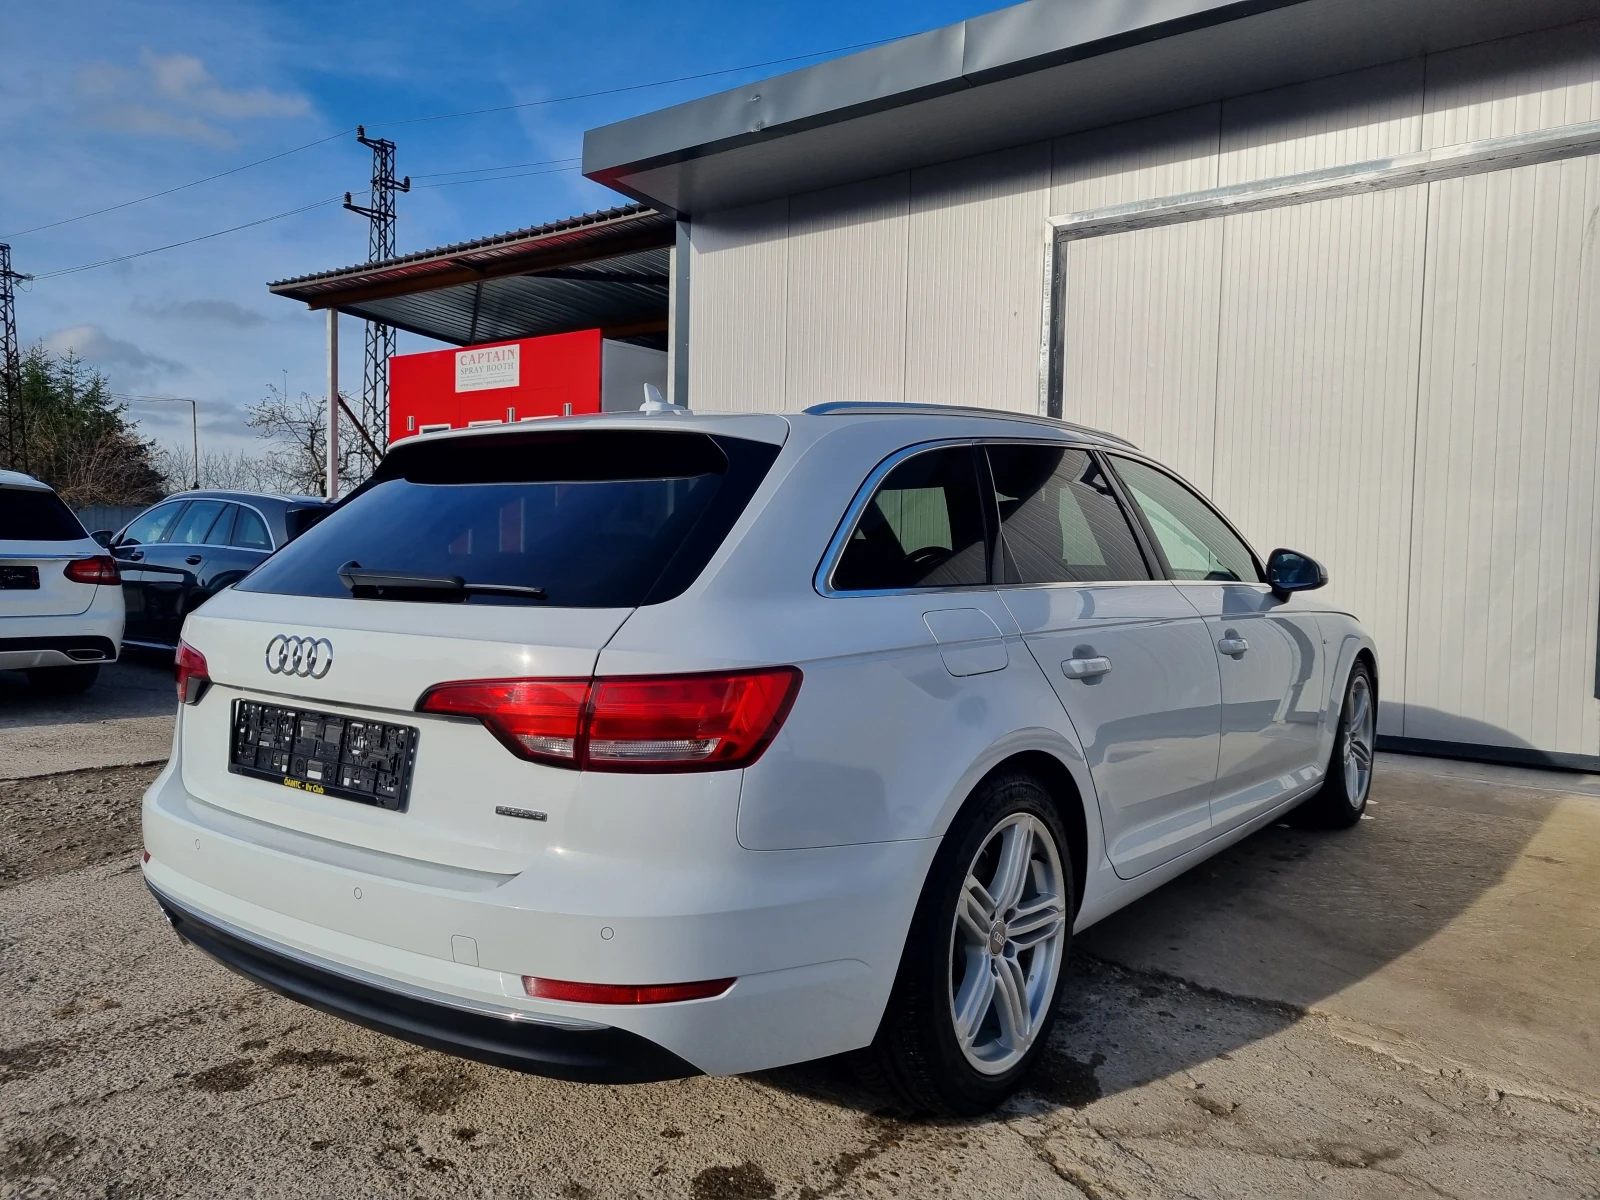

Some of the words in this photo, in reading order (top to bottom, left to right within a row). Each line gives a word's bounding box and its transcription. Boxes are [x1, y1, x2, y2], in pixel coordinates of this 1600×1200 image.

[460, 348, 515, 366] CAPTAIN
[460, 366, 484, 376] SPRAY
[486, 362, 514, 372] BOOTH
[312, 784, 324, 794] Club
